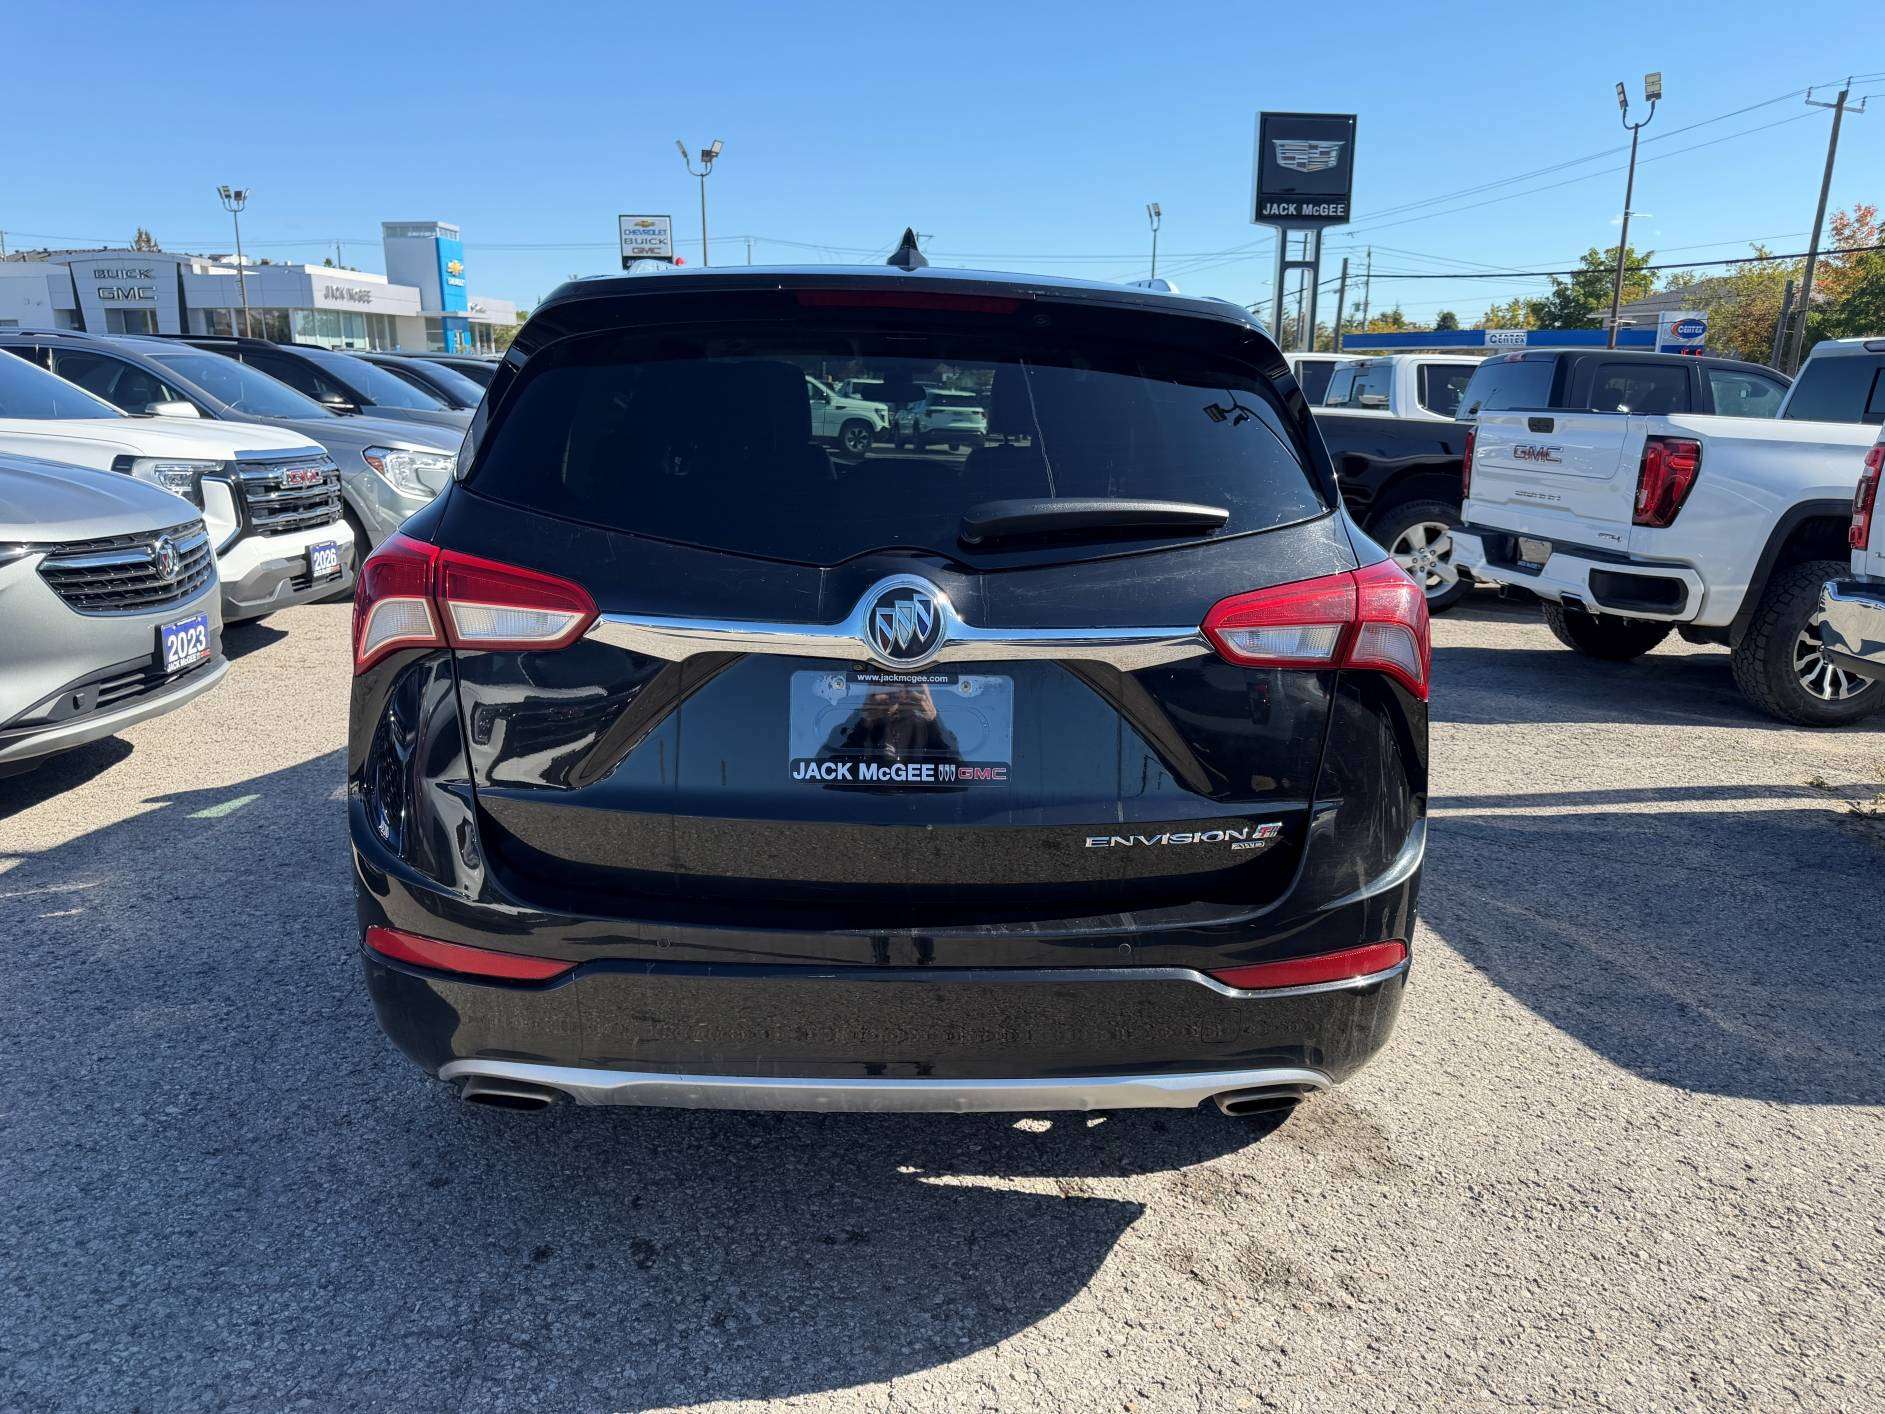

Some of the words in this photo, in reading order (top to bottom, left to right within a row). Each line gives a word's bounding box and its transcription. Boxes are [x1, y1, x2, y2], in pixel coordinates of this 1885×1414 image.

[1262, 203, 1297, 215] JACK
[1301, 204, 1345, 216] McGEE
[624, 237, 668, 246] BUICK
[632, 247, 662, 255] GMC
[93, 268, 155, 280] BUICK
[97, 286, 157, 300] GMC
[1513, 444, 1564, 464] GMC
[313, 547, 338, 571] 2026
[167, 625, 206, 663] 2023
[857, 673, 948, 684] www.jackmcgee.com
[792, 762, 853, 780] JACK
[858, 763, 935, 781] McGEE
[958, 766, 1007, 780] GMC
[1086, 828, 1249, 848] ENVISION
